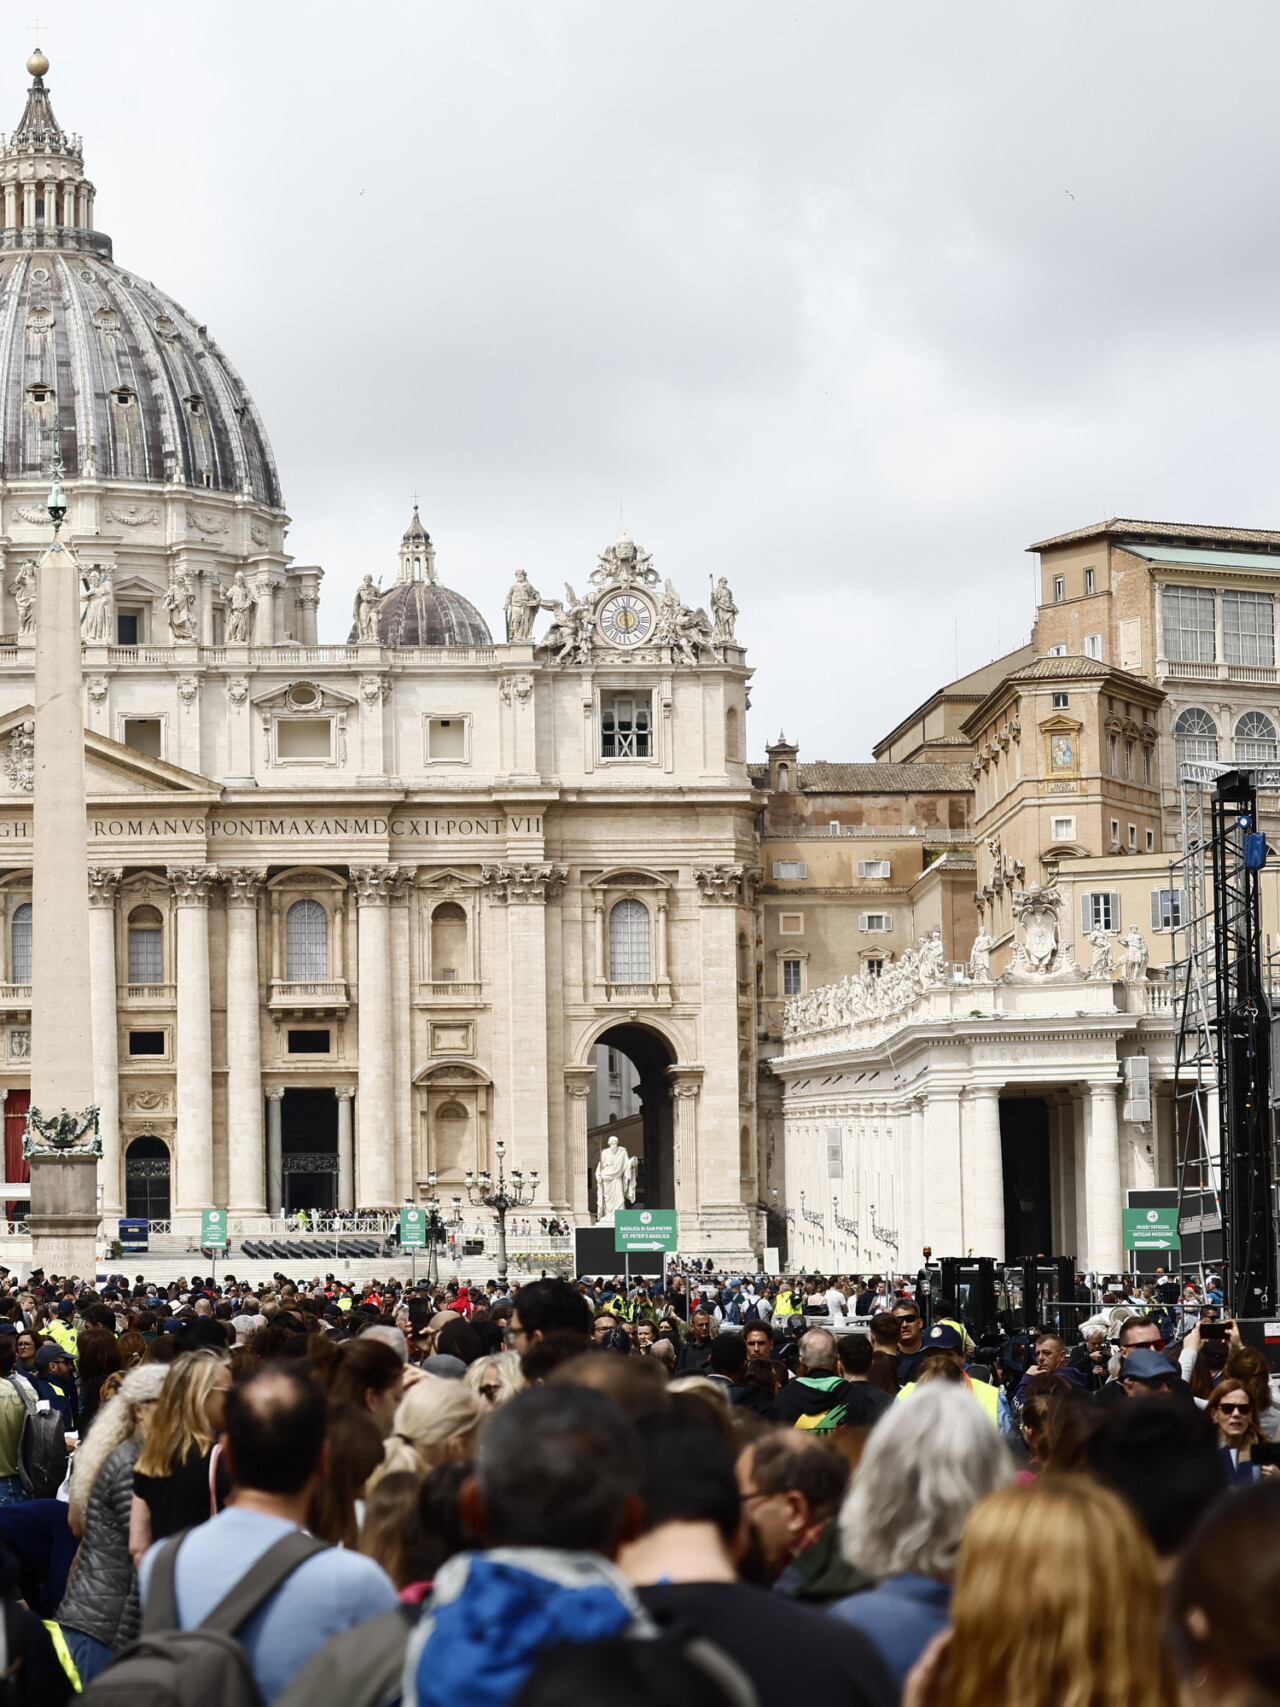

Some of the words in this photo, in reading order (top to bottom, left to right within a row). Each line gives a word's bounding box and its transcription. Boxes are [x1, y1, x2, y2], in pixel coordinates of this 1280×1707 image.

[94, 819, 205, 836] ROMANVS
[210, 819, 267, 836] PONT
[269, 819, 318, 835] MAX
[319, 819, 348, 835] AN
[353, 818, 439, 836] MDCXII
[446, 819, 504, 836] PONT
[510, 817, 541, 833] VII
